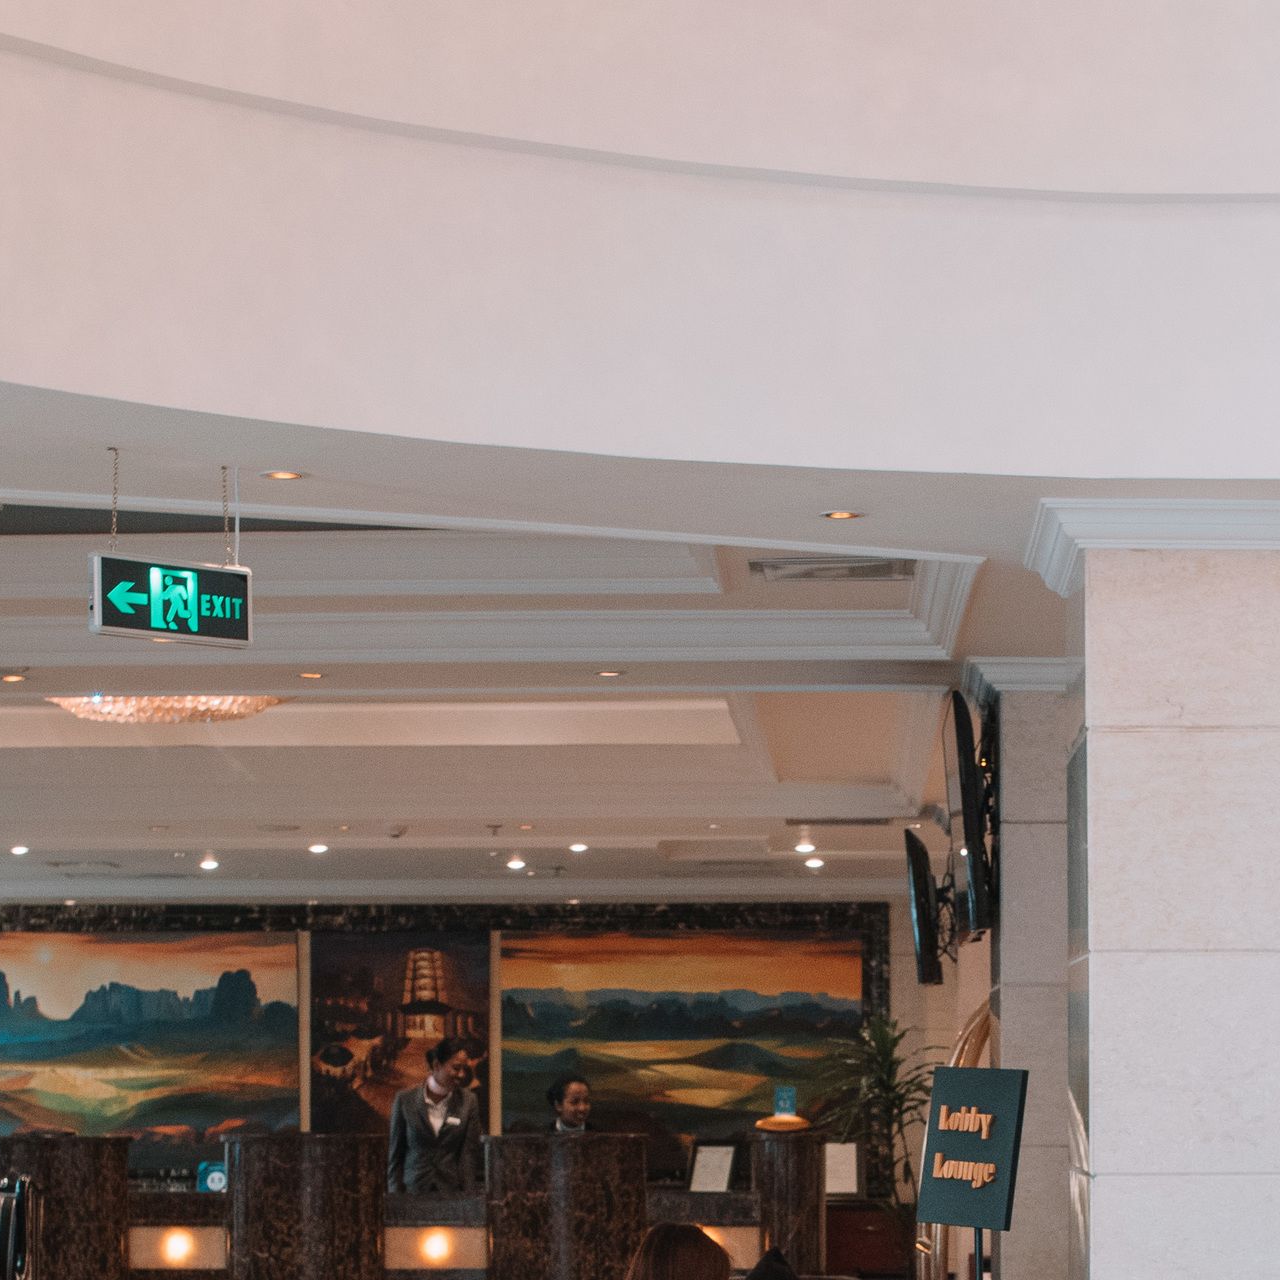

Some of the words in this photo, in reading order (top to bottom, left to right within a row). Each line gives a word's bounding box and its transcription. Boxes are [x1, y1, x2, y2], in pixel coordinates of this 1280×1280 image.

[200, 594, 243, 620] EXIT
[937, 1104, 994, 1140] Lobby
[931, 1152, 997, 1189] Lounge
